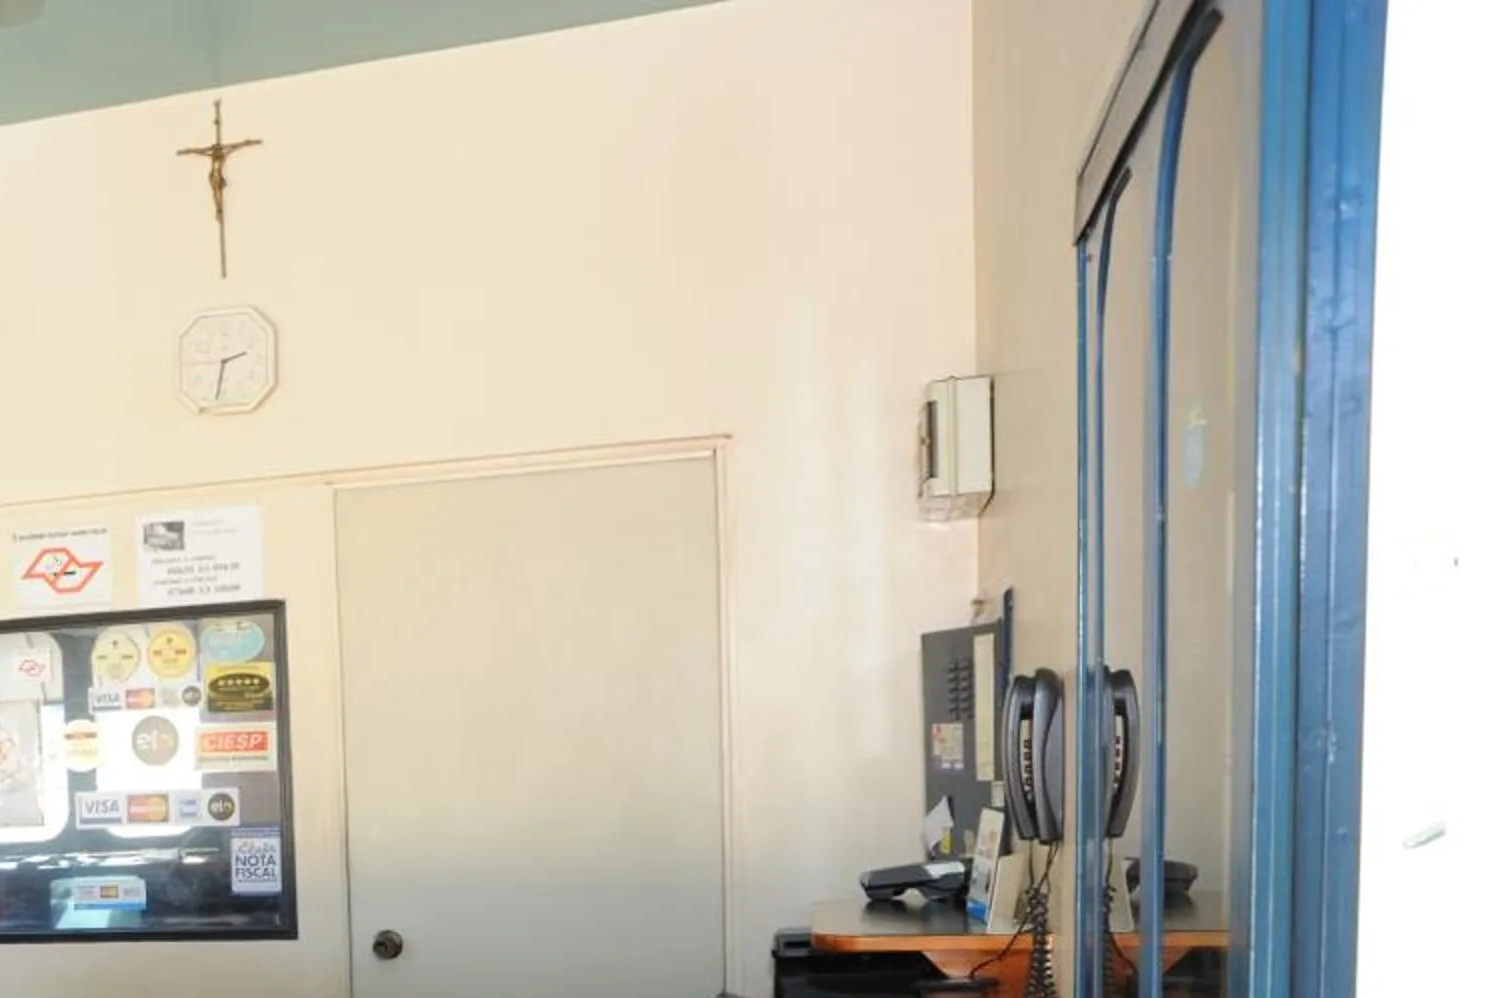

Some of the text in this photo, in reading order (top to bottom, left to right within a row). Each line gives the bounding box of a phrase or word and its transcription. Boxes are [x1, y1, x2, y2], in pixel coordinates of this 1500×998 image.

[93, 692, 120, 704] VISA
[203, 734, 263, 750] CIESP
[84, 799, 120, 814] VISA
[210, 799, 234, 815] elo
[235, 854, 276, 867] NOTA
[235, 867, 276, 879] FISCAL
